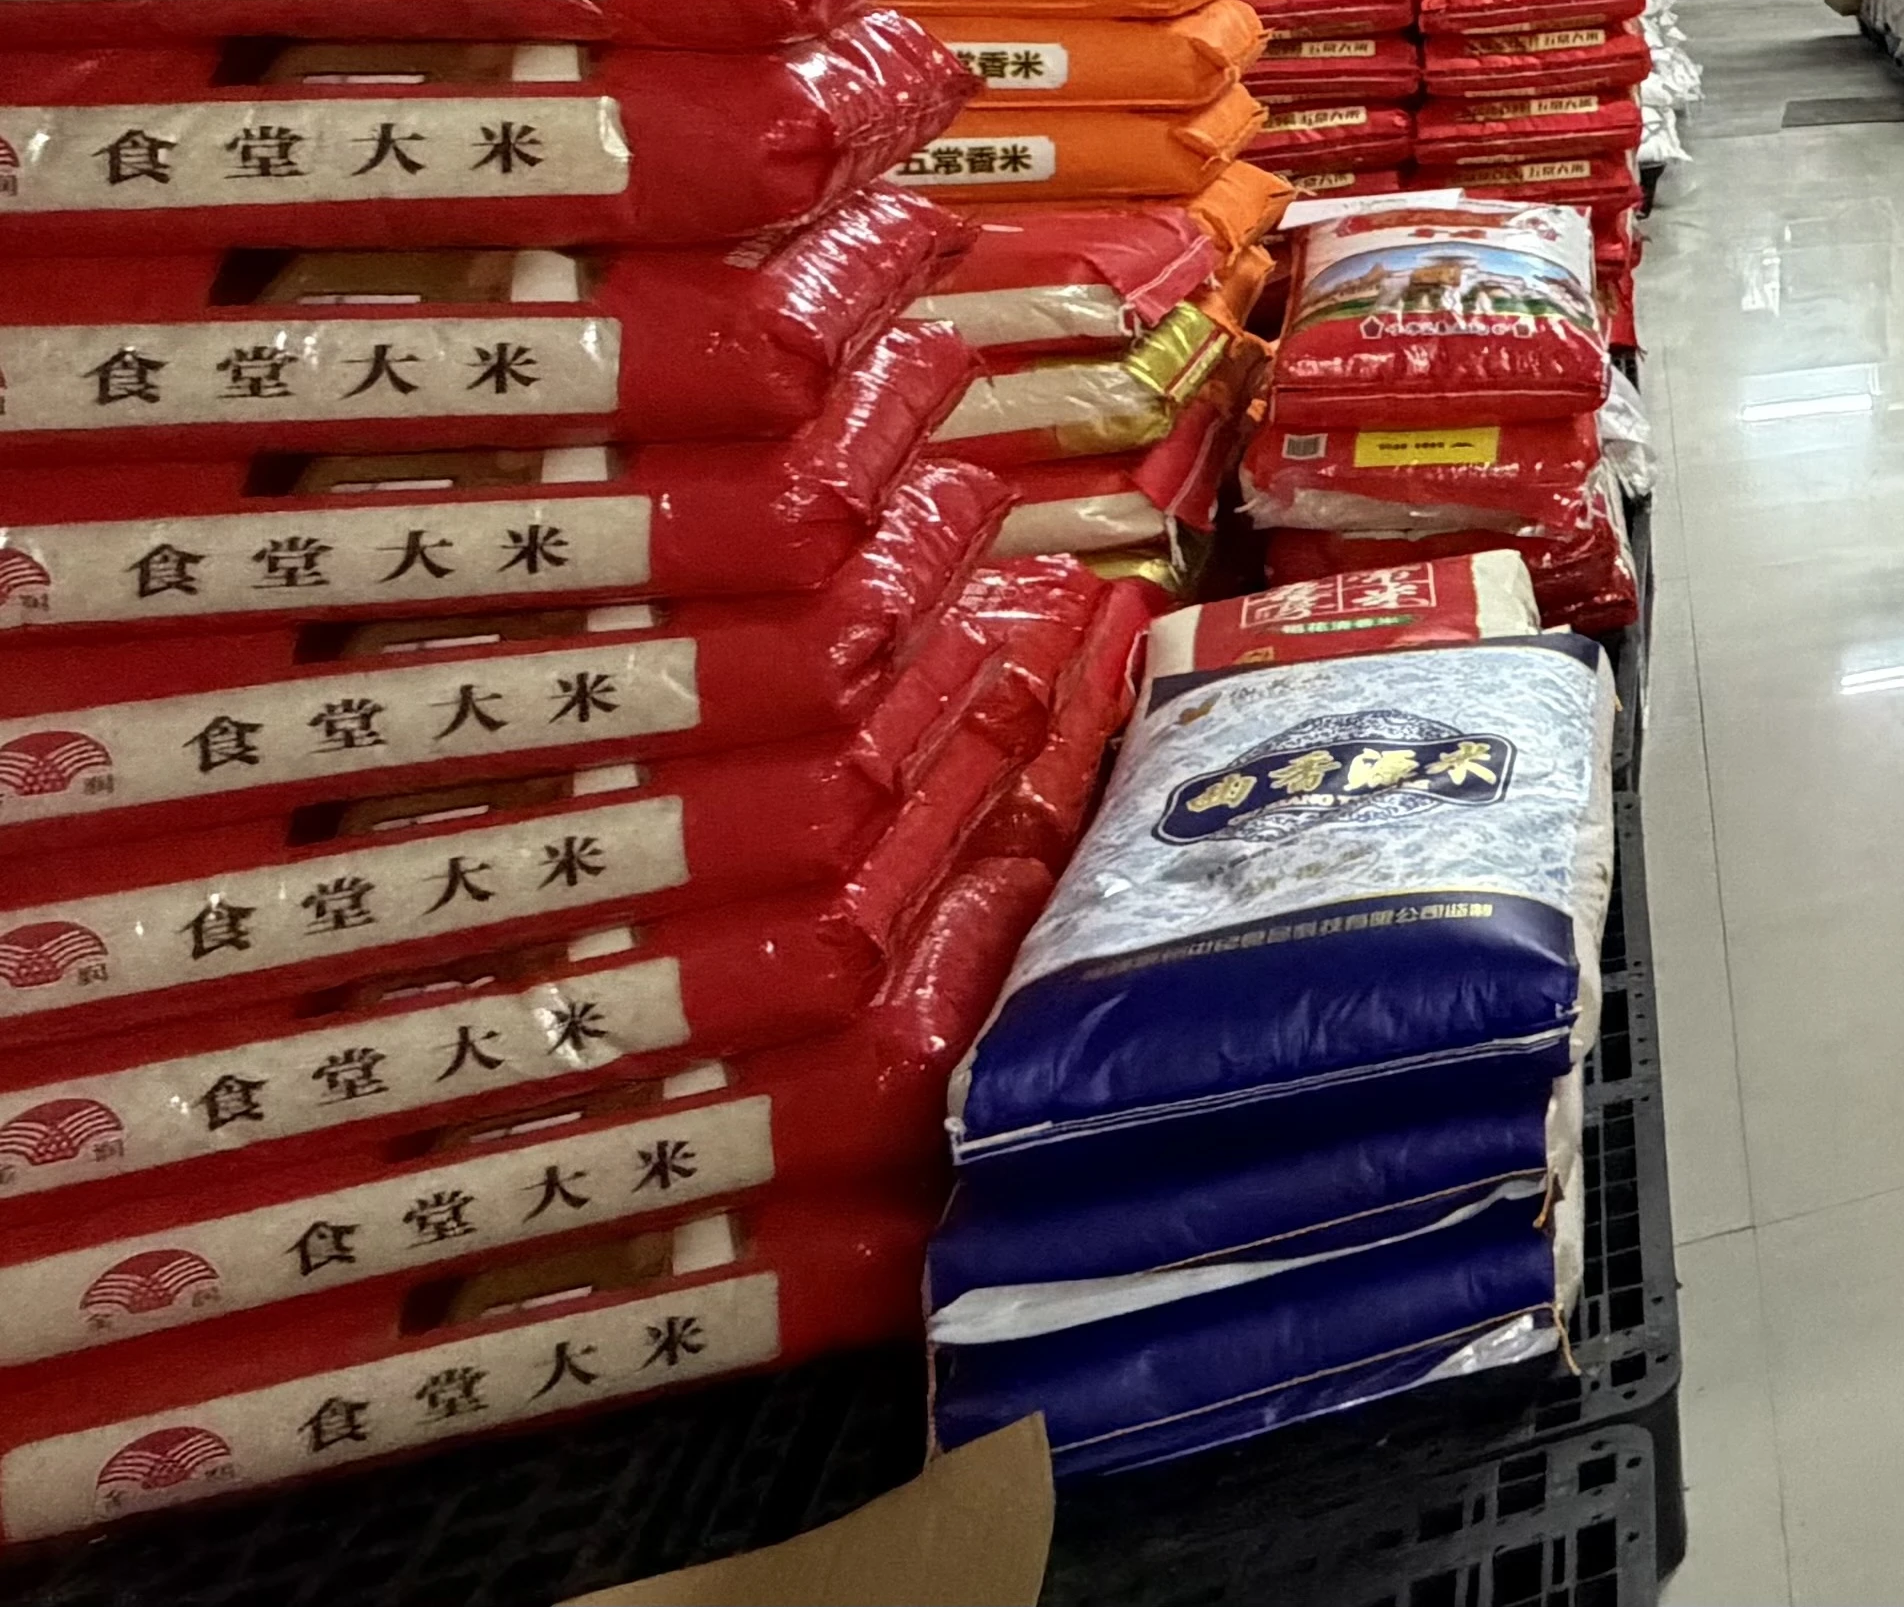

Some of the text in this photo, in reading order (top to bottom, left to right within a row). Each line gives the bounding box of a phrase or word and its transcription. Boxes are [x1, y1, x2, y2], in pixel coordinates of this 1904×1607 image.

[94, 120, 545, 186] 食堂大米
[83, 342, 542, 406] 食堂大米
[128, 524, 571, 596] 食堂大米
[183, 670, 620, 774] 食堂大米
[178, 834, 608, 961] 食堂大米
[194, 999, 609, 1133] 食堂大米
[286, 1138, 699, 1278] 食堂大米
[298, 1314, 706, 1454] 食堂大米
